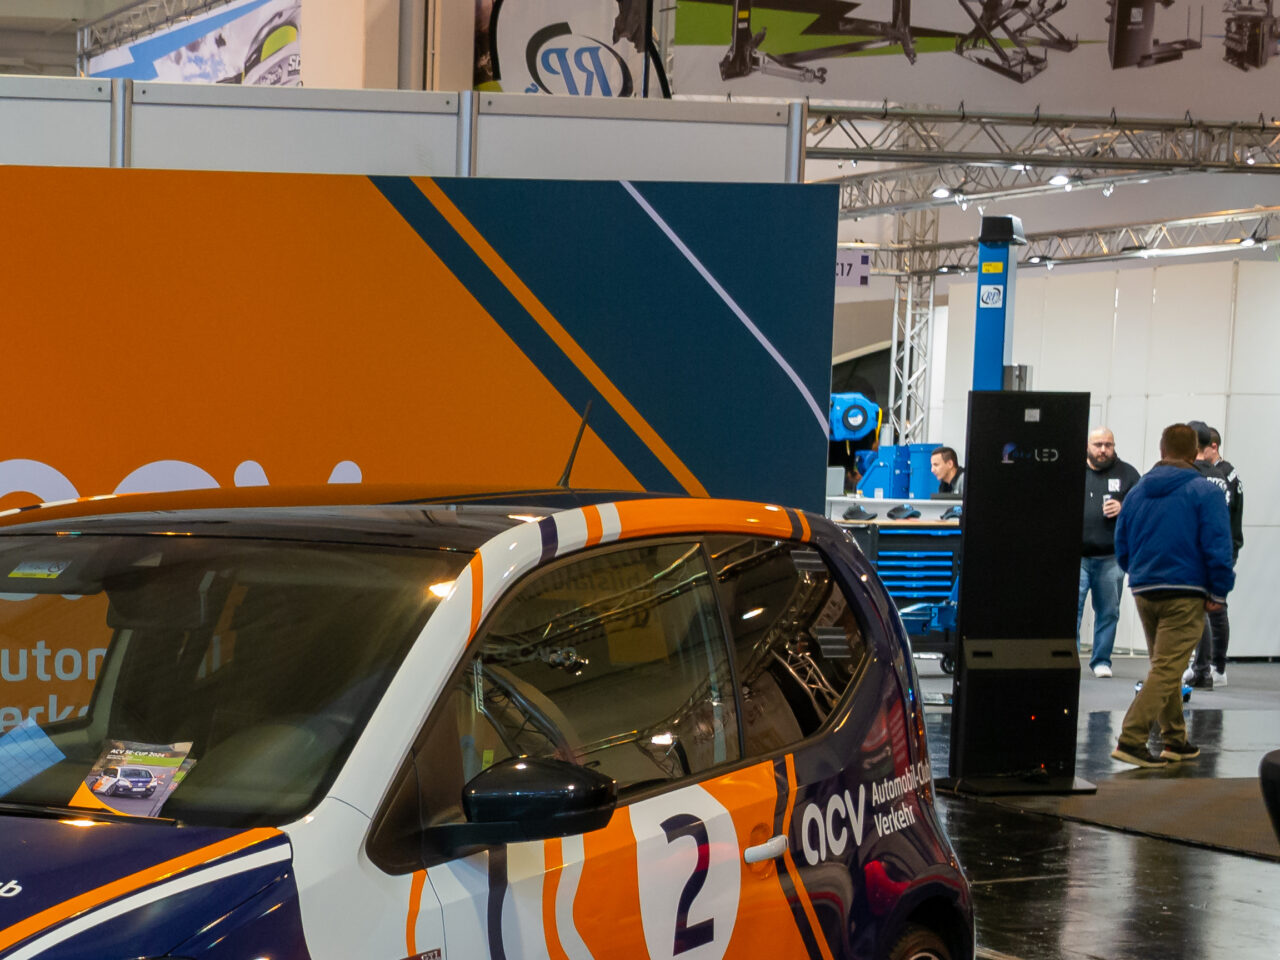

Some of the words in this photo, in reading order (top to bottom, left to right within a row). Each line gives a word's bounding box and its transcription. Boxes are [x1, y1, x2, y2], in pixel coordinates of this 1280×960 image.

[836, 262, 853, 277] 17
[871, 758, 932, 806] Automobil-Club
[801, 783, 865, 866] acv
[874, 801, 916, 838] Verkehr
[658, 813, 715, 957] 2
